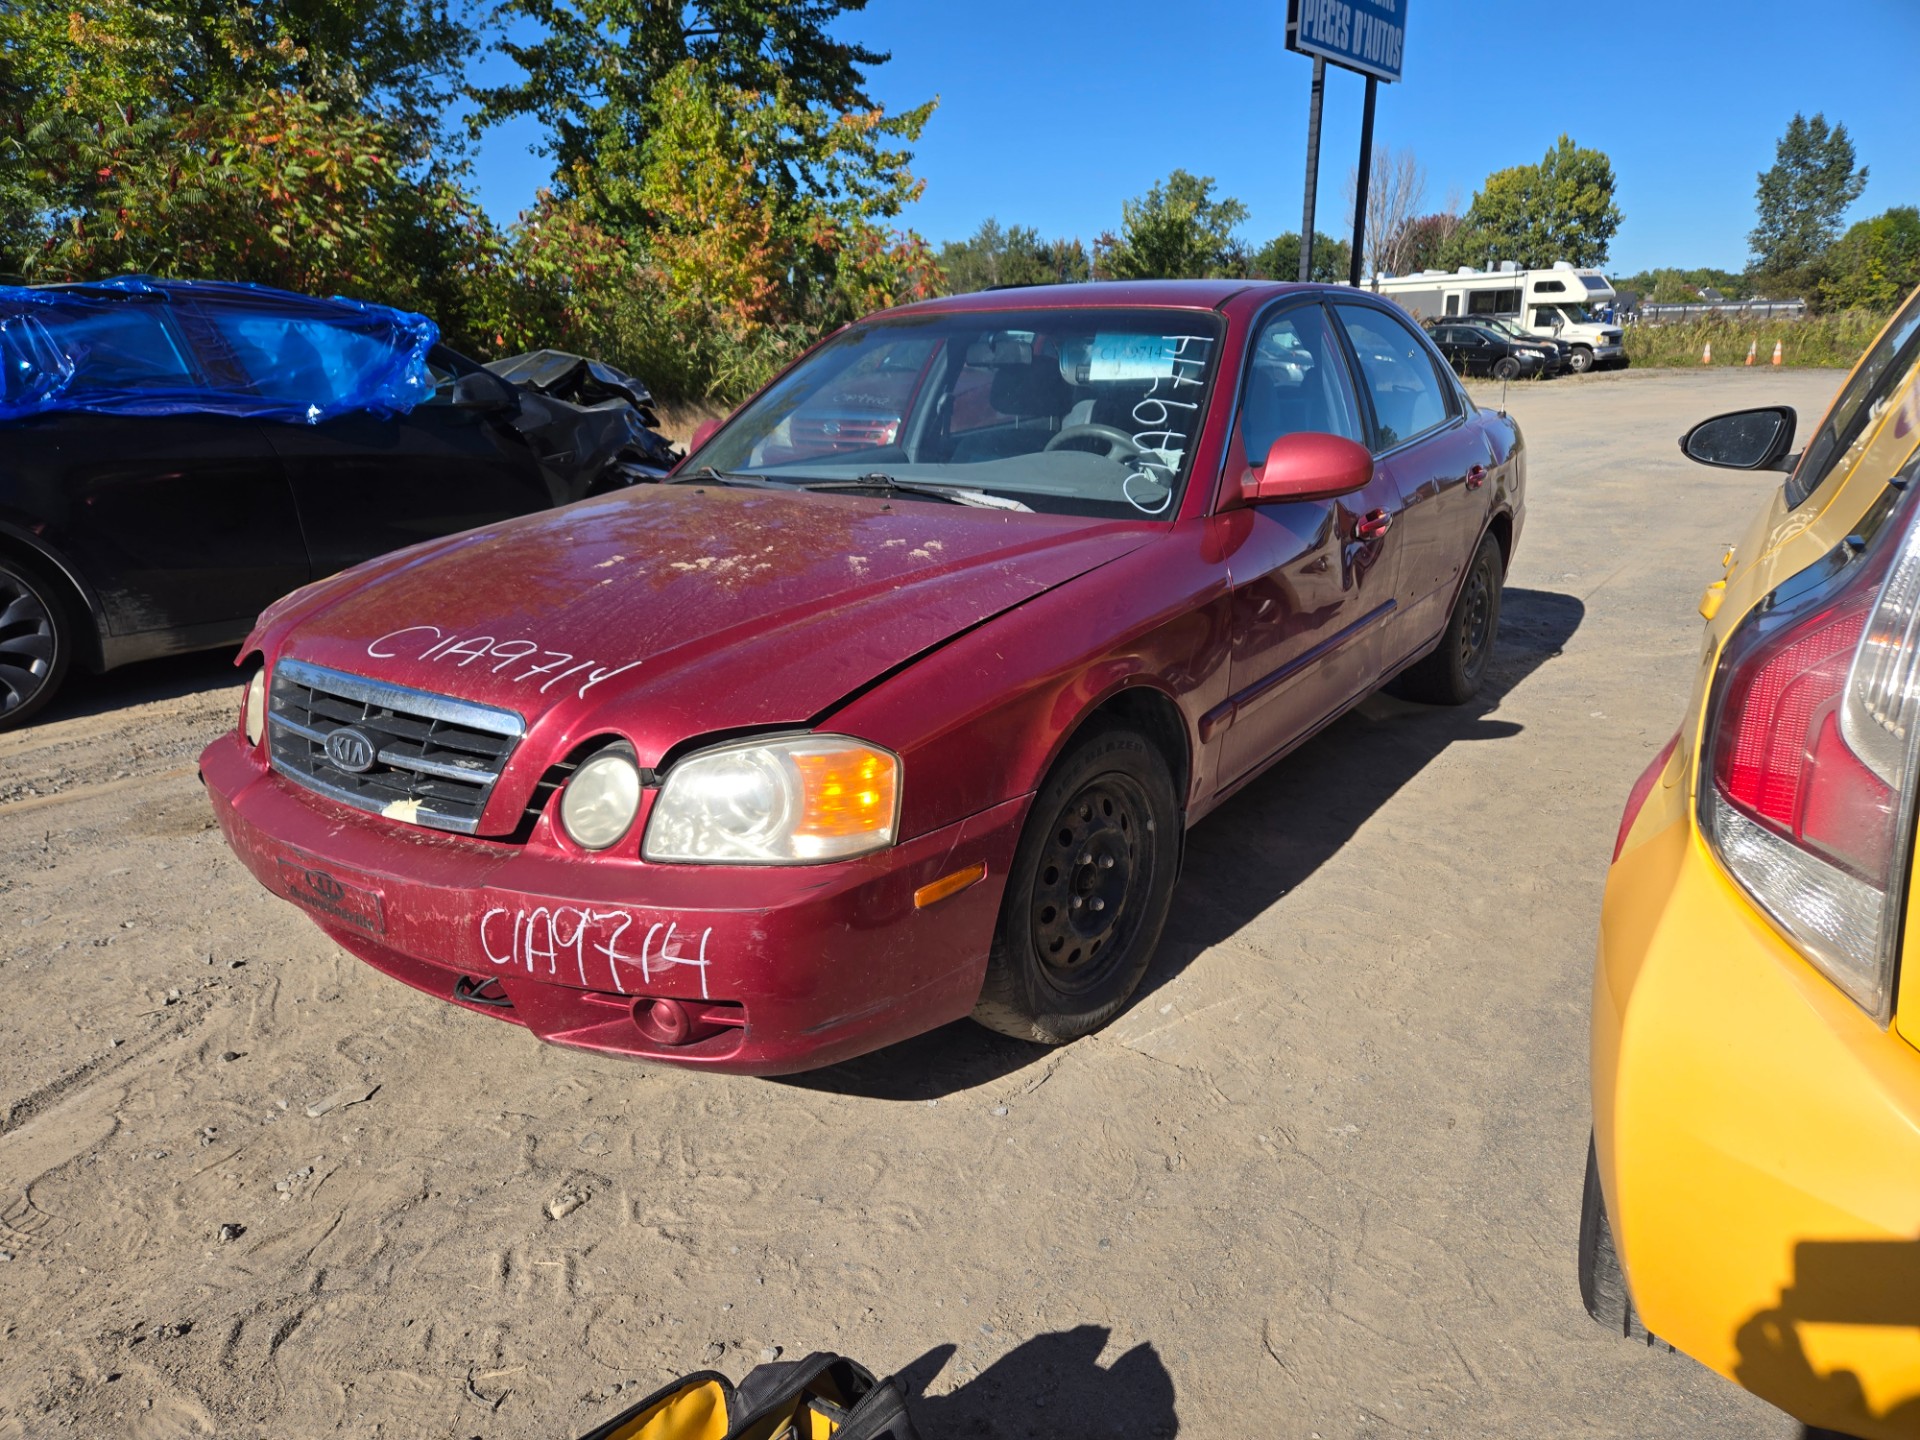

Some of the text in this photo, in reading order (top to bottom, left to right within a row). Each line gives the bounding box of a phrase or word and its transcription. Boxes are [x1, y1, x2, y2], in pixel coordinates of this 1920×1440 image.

[1352, 9, 1402, 70] D'AUTOS
[1100, 345, 1164, 361] CI9714
[368, 626, 642, 699] CIA9714
[332, 735, 365, 765] KIA
[481, 907, 712, 1000] CIA9714
